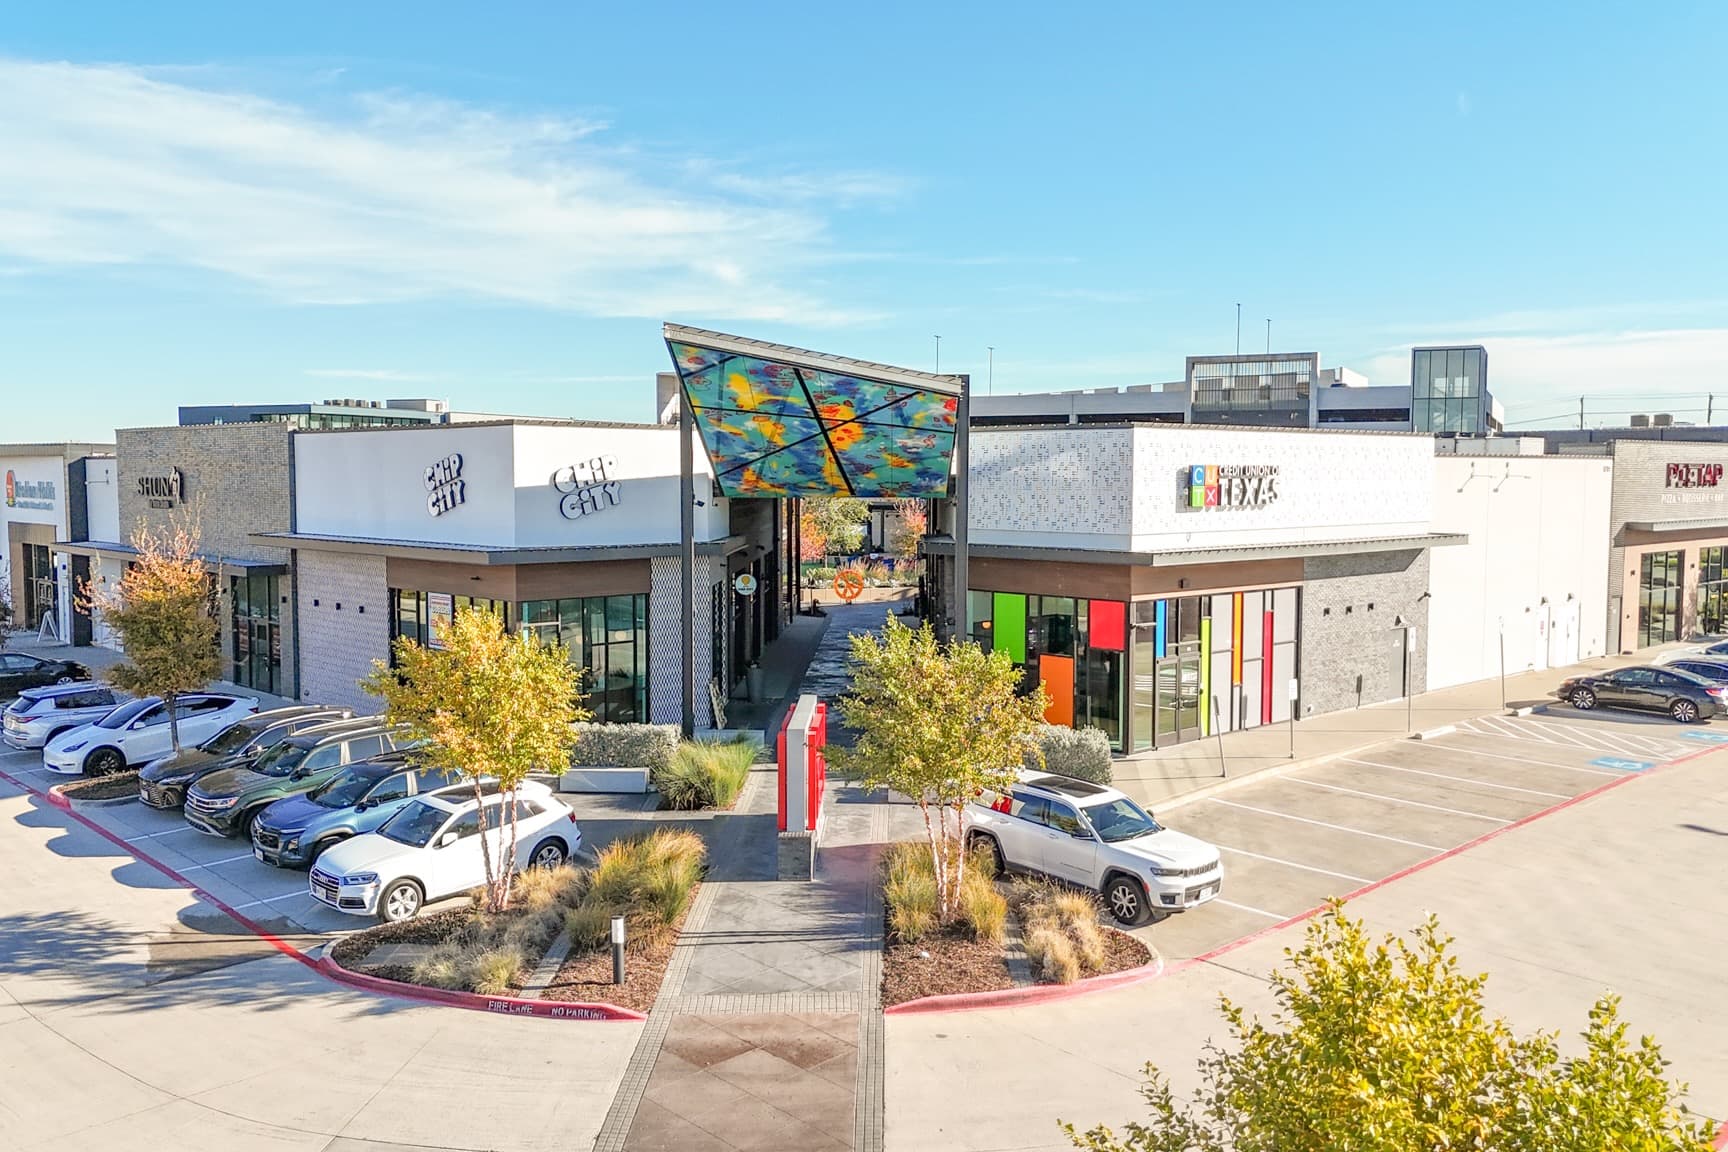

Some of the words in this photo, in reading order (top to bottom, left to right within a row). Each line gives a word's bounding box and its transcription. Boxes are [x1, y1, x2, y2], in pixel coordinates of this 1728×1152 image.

[1219, 465, 1241, 476] CREDIT
[1244, 465, 1269, 476] UNION
[1219, 478, 1280, 505] TEXAS
[488, 1000, 508, 1011] FIRE
[509, 1001, 533, 1014] LANE
[551, 1007, 564, 1017] NO
